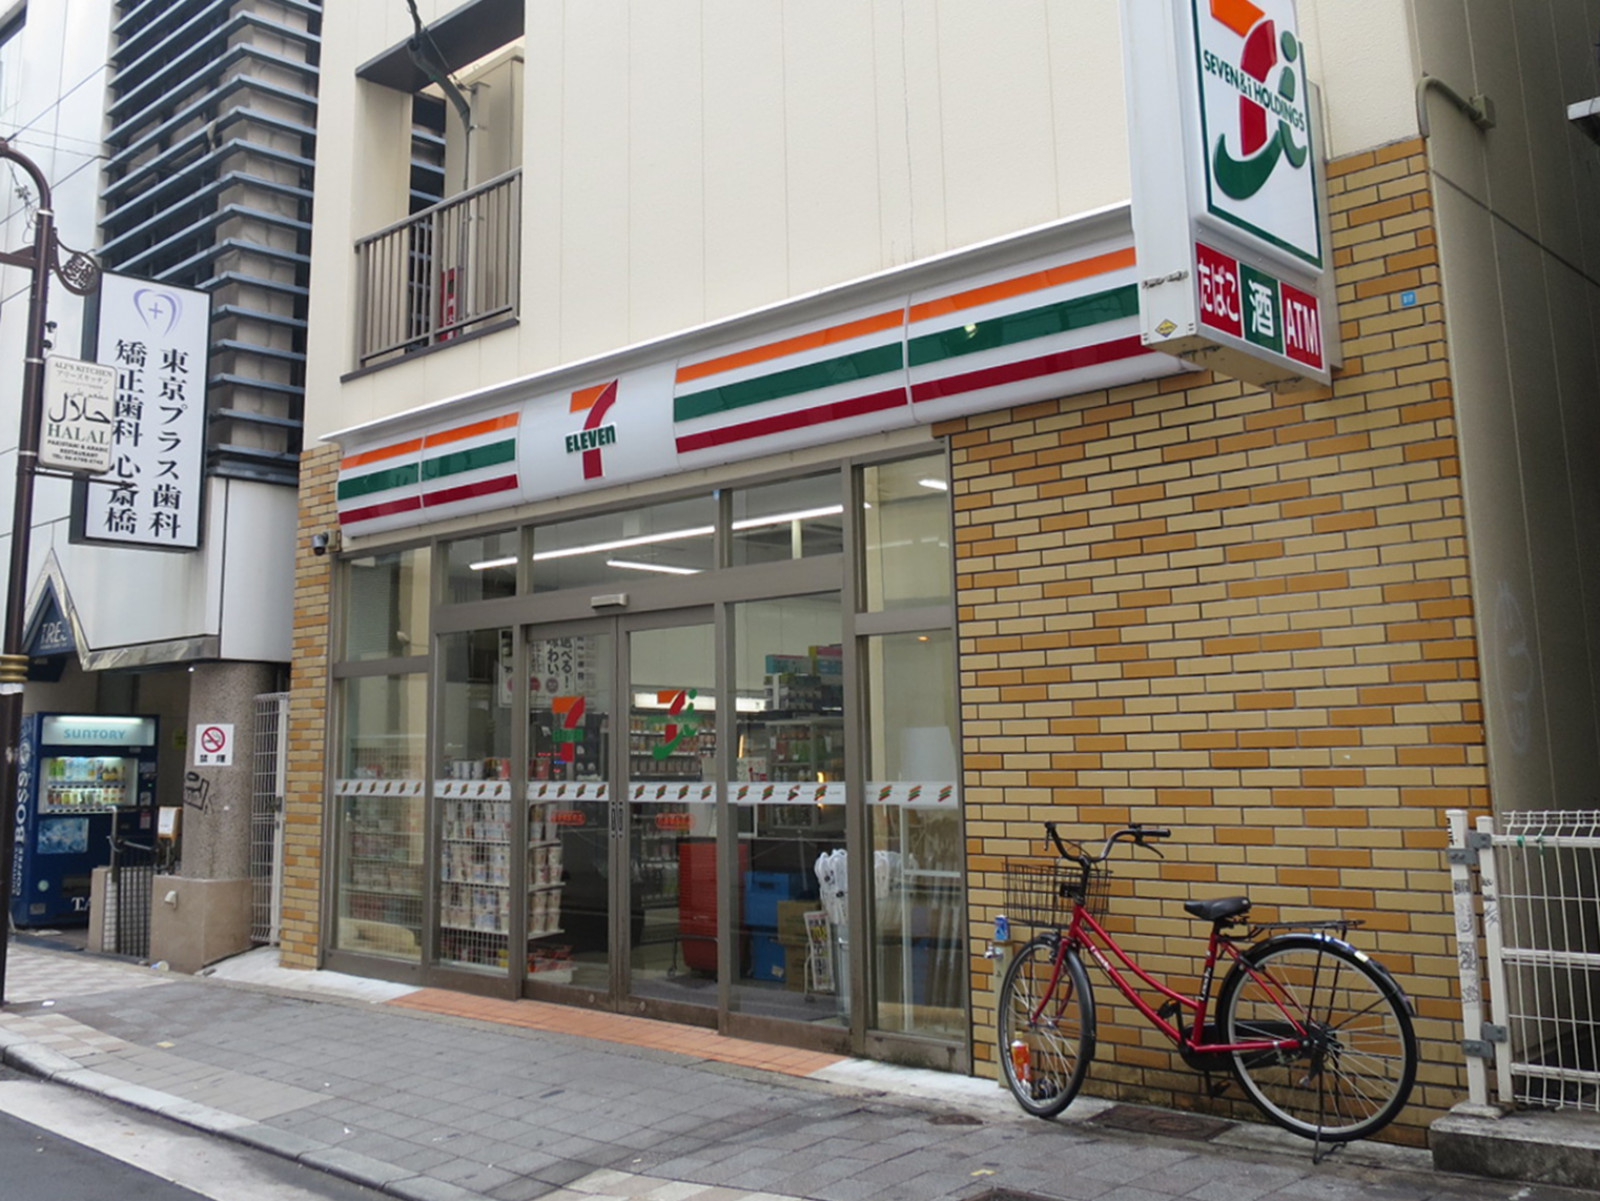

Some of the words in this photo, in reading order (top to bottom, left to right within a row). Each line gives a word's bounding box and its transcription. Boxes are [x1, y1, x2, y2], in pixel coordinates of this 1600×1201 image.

[1253, 81, 1305, 133] HOLDINGS
[1198, 257, 1240, 323] たばこ
[1248, 278, 1275, 338] 酒
[1286, 297, 1320, 357] ATM
[48, 391, 111, 424] حلال
[112, 338, 147, 448] 矯正歯科
[47, 422, 110, 445] HALAL
[148, 348, 190, 539] 東京プラス歯科
[102, 453, 142, 536] 心斎橋
[14, 772, 29, 843] BOSS
